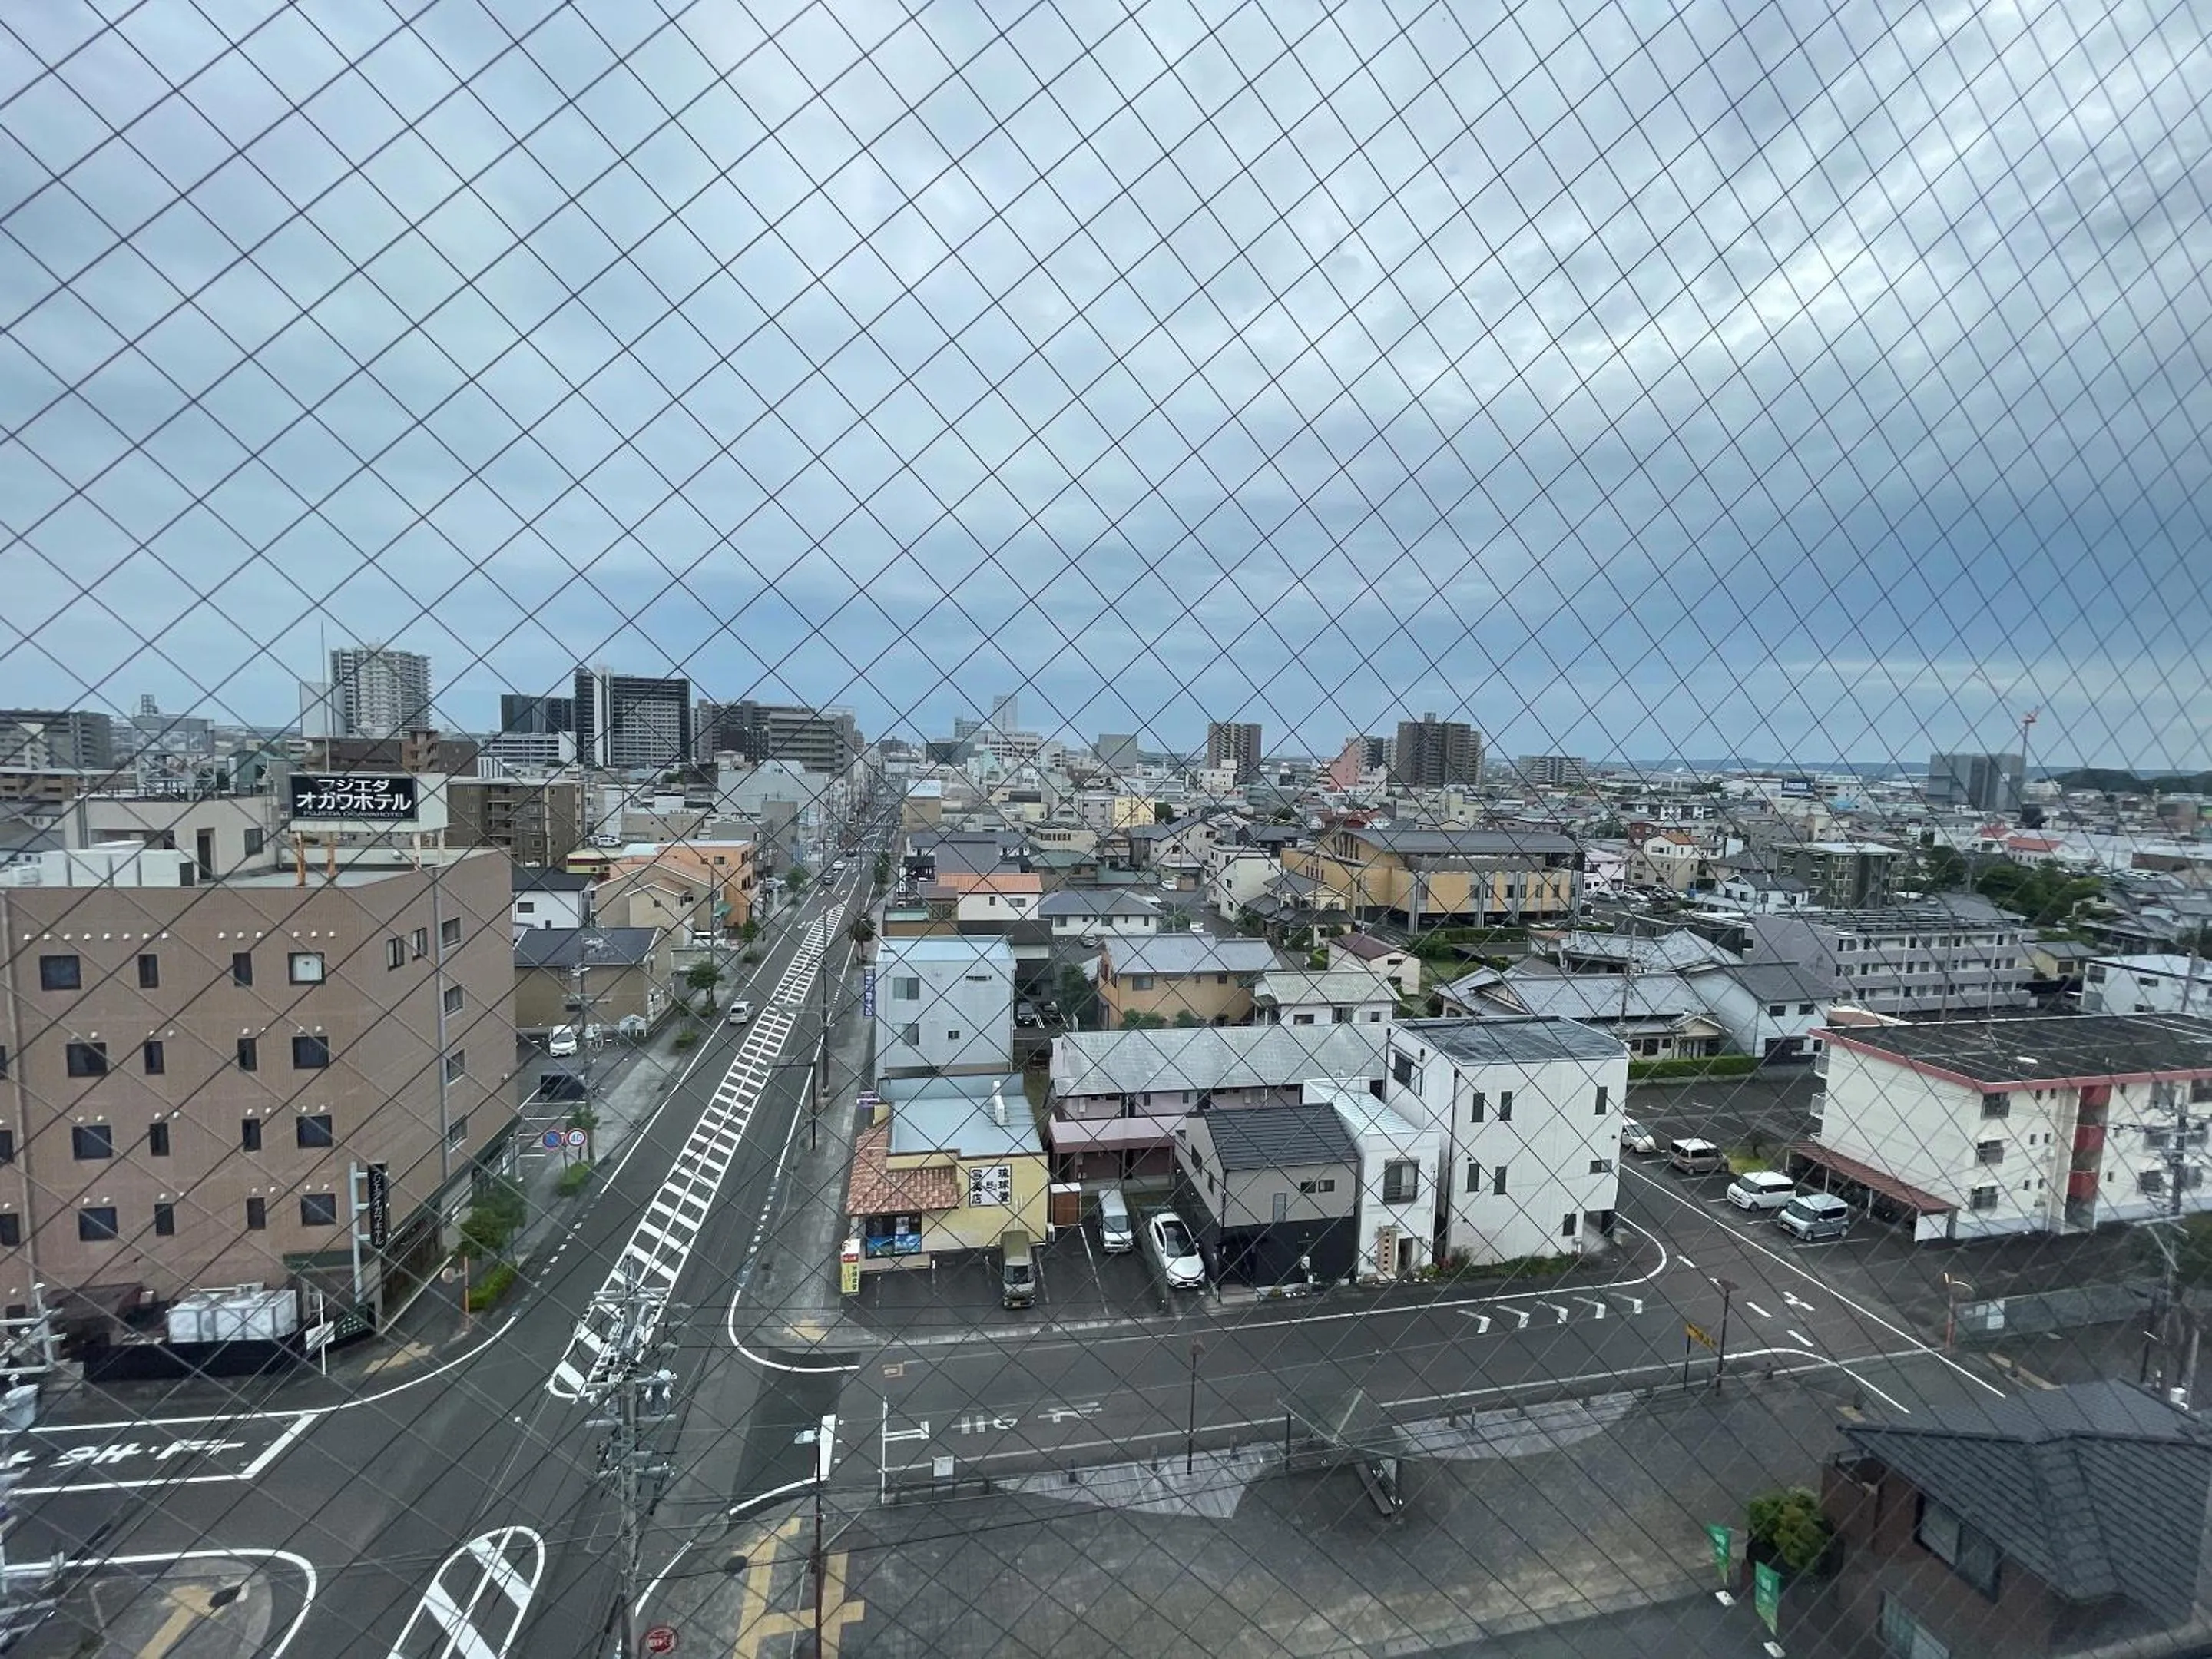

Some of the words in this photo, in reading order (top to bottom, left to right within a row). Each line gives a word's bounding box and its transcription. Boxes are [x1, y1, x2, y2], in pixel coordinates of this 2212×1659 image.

[318, 778, 390, 793] フジエダ
[296, 791, 412, 810] オガワホテル
